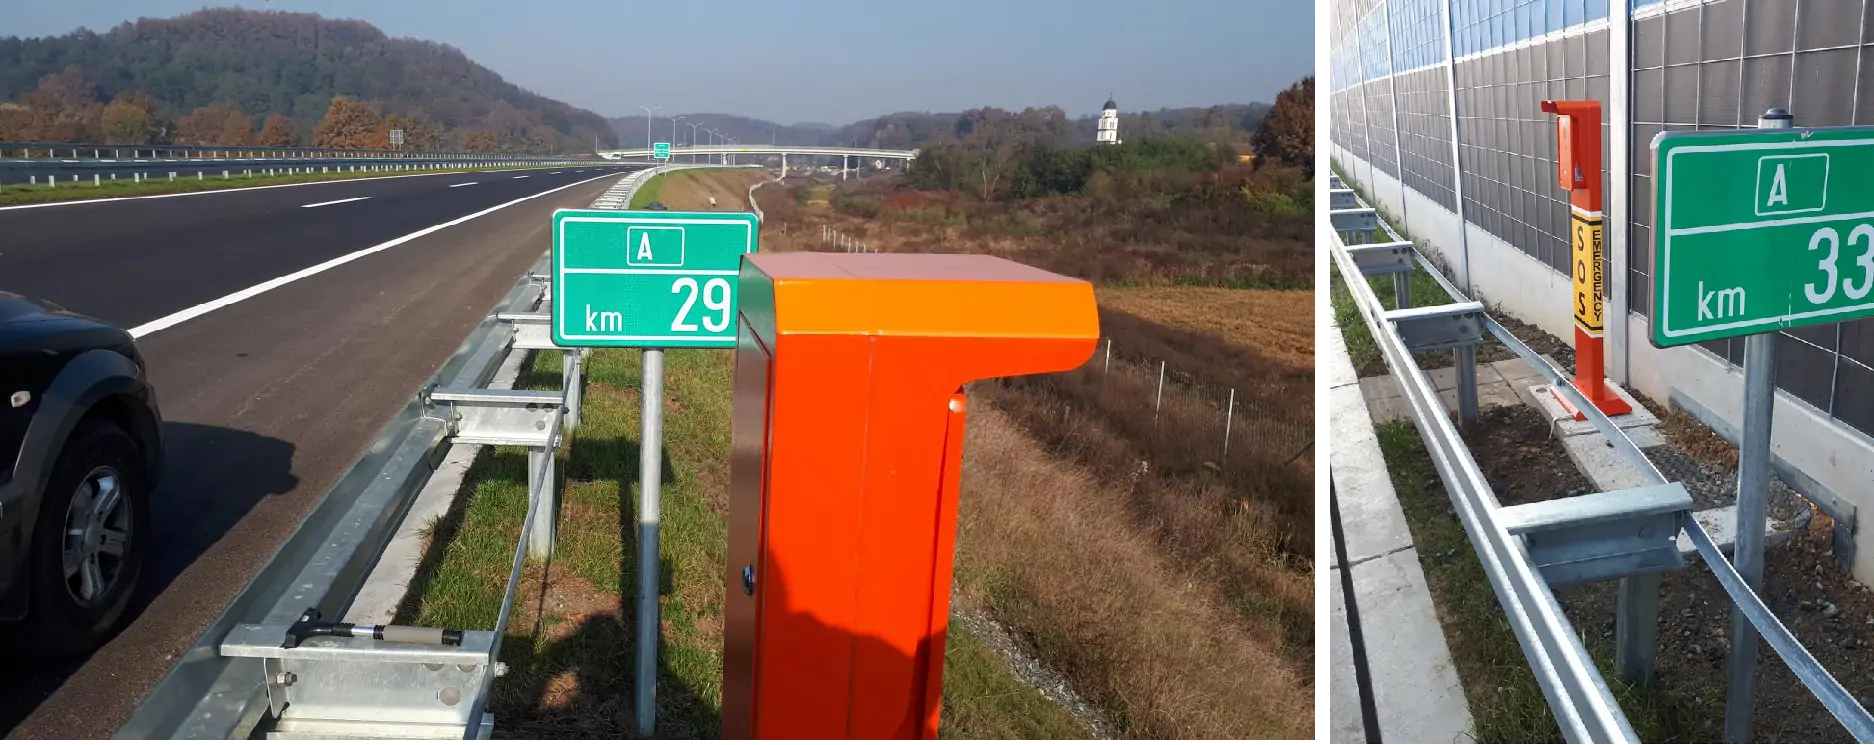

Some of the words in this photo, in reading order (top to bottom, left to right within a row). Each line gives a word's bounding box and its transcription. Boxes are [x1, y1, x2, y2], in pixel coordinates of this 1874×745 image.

[1767, 163, 1788, 207] A
[636, 231, 653, 261] A
[1577, 225, 1586, 316] SOS
[1592, 229, 1602, 322] EMERGENCY
[1697, 280, 1746, 322] km
[1804, 223, 1874, 305] 33
[585, 303, 623, 332] km
[670, 277, 731, 333] 29
